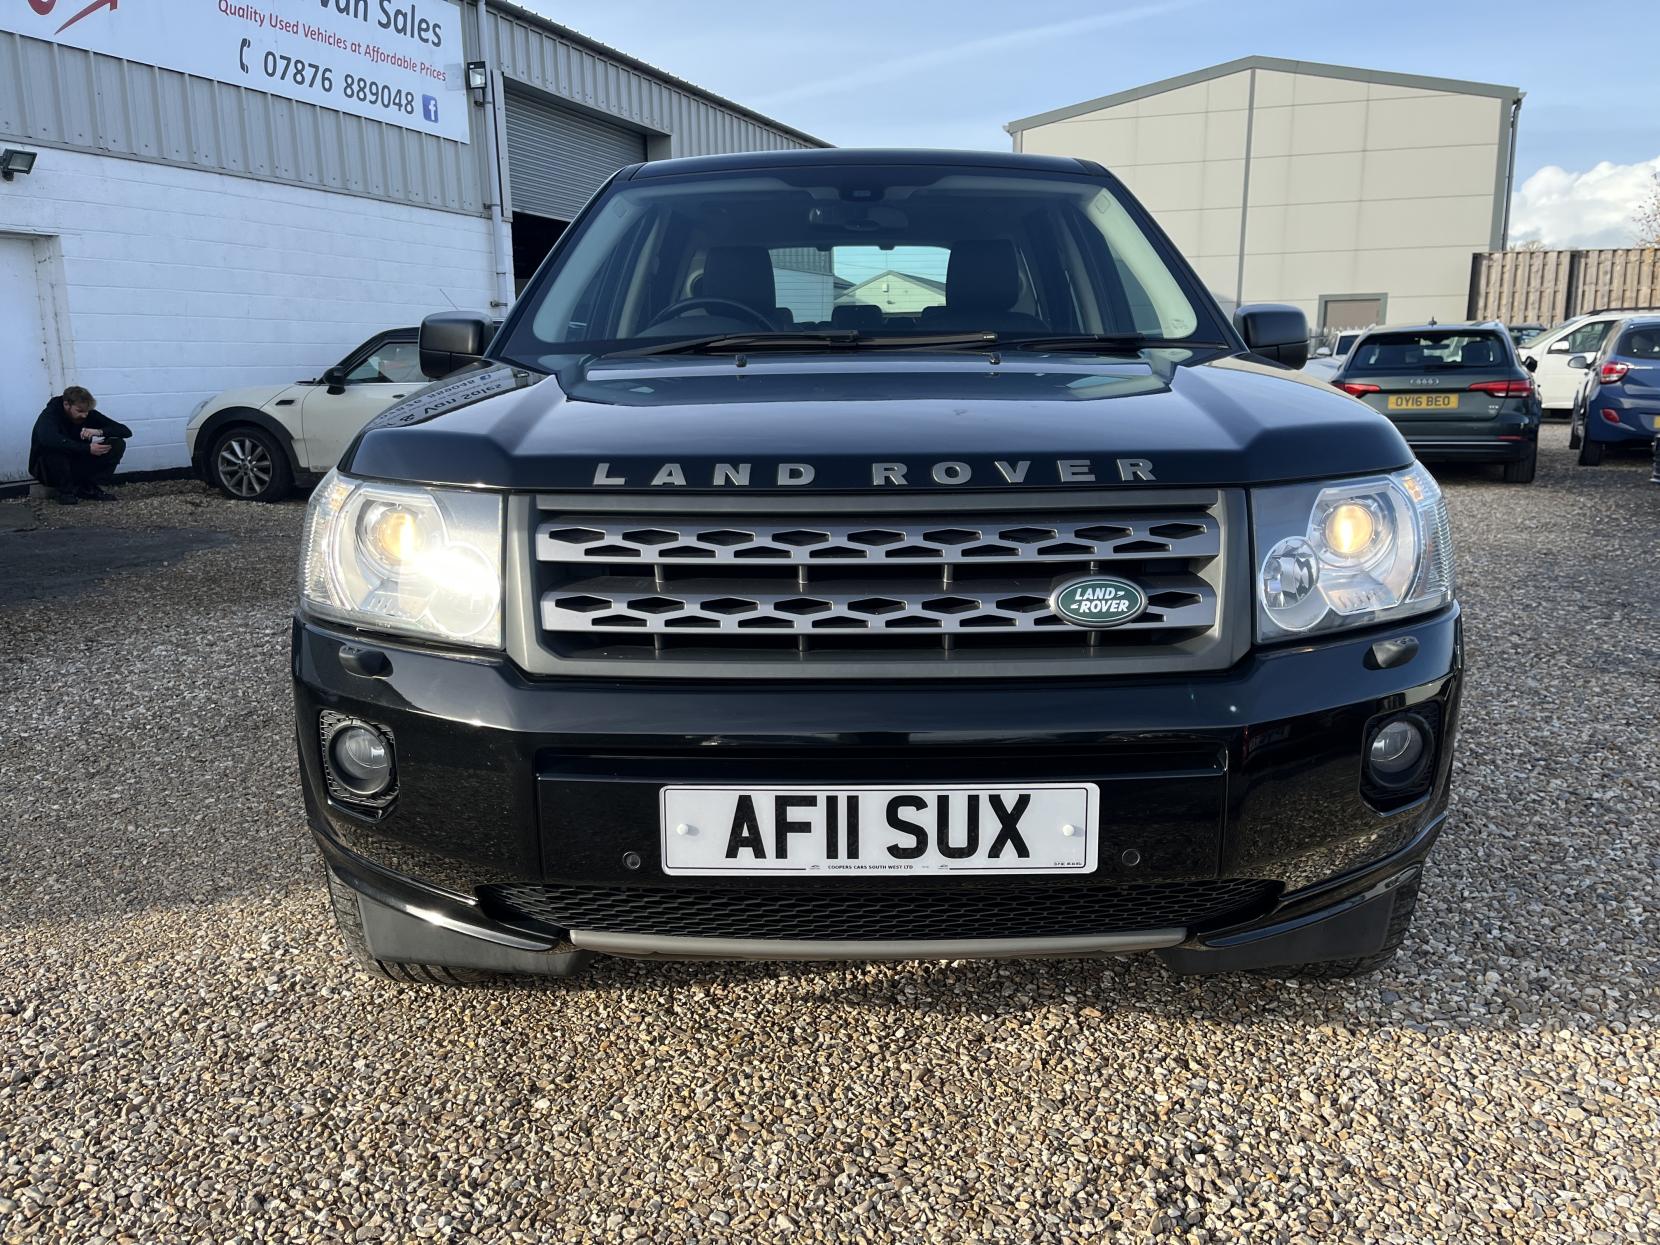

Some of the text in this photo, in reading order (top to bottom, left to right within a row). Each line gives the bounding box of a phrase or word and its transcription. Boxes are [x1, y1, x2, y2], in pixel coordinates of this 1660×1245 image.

[218, 0, 447, 82] Quality Used Vehicles at Affordable Prices
[320, 0, 442, 48] an Sales
[264, 50, 415, 115] 07876 889048
[1395, 395, 1451, 407] OY16 BEO
[593, 458, 1157, 486] LAND ROVER
[1075, 587, 1115, 600] LAND
[1079, 600, 1129, 613] ROVER
[725, 794, 1031, 860] AF11 SUX
